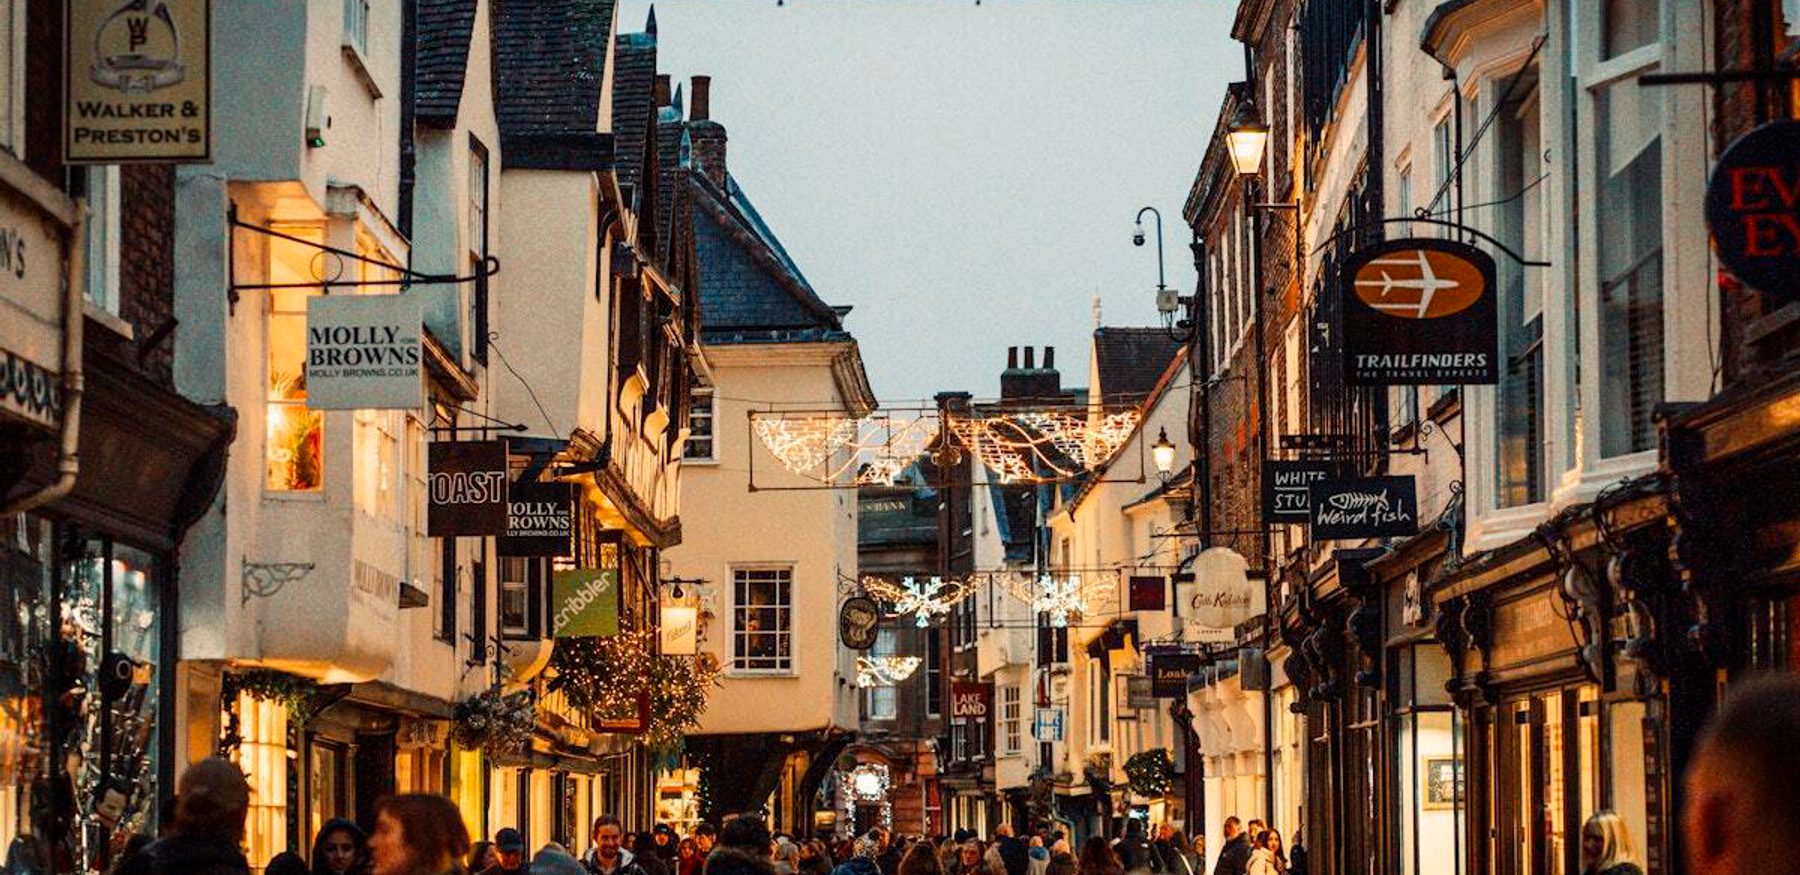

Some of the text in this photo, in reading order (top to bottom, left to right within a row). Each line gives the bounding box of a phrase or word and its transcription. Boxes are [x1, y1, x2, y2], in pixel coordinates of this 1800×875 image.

[77, 100, 198, 118] WALKER &
[74, 127, 201, 143] PRESTON'S
[310, 326, 399, 345] MOLLY
[310, 347, 419, 366] BROWNS
[1356, 353, 1487, 369] TRAILFINDERS
[1275, 470, 1327, 486] WHITE
[1274, 492, 1310, 509] STU
[1371, 499, 1411, 527] fish
[508, 516, 570, 529] ROWNS
[953, 693, 981, 703] LAKE
[954, 704, 987, 716] LAND
